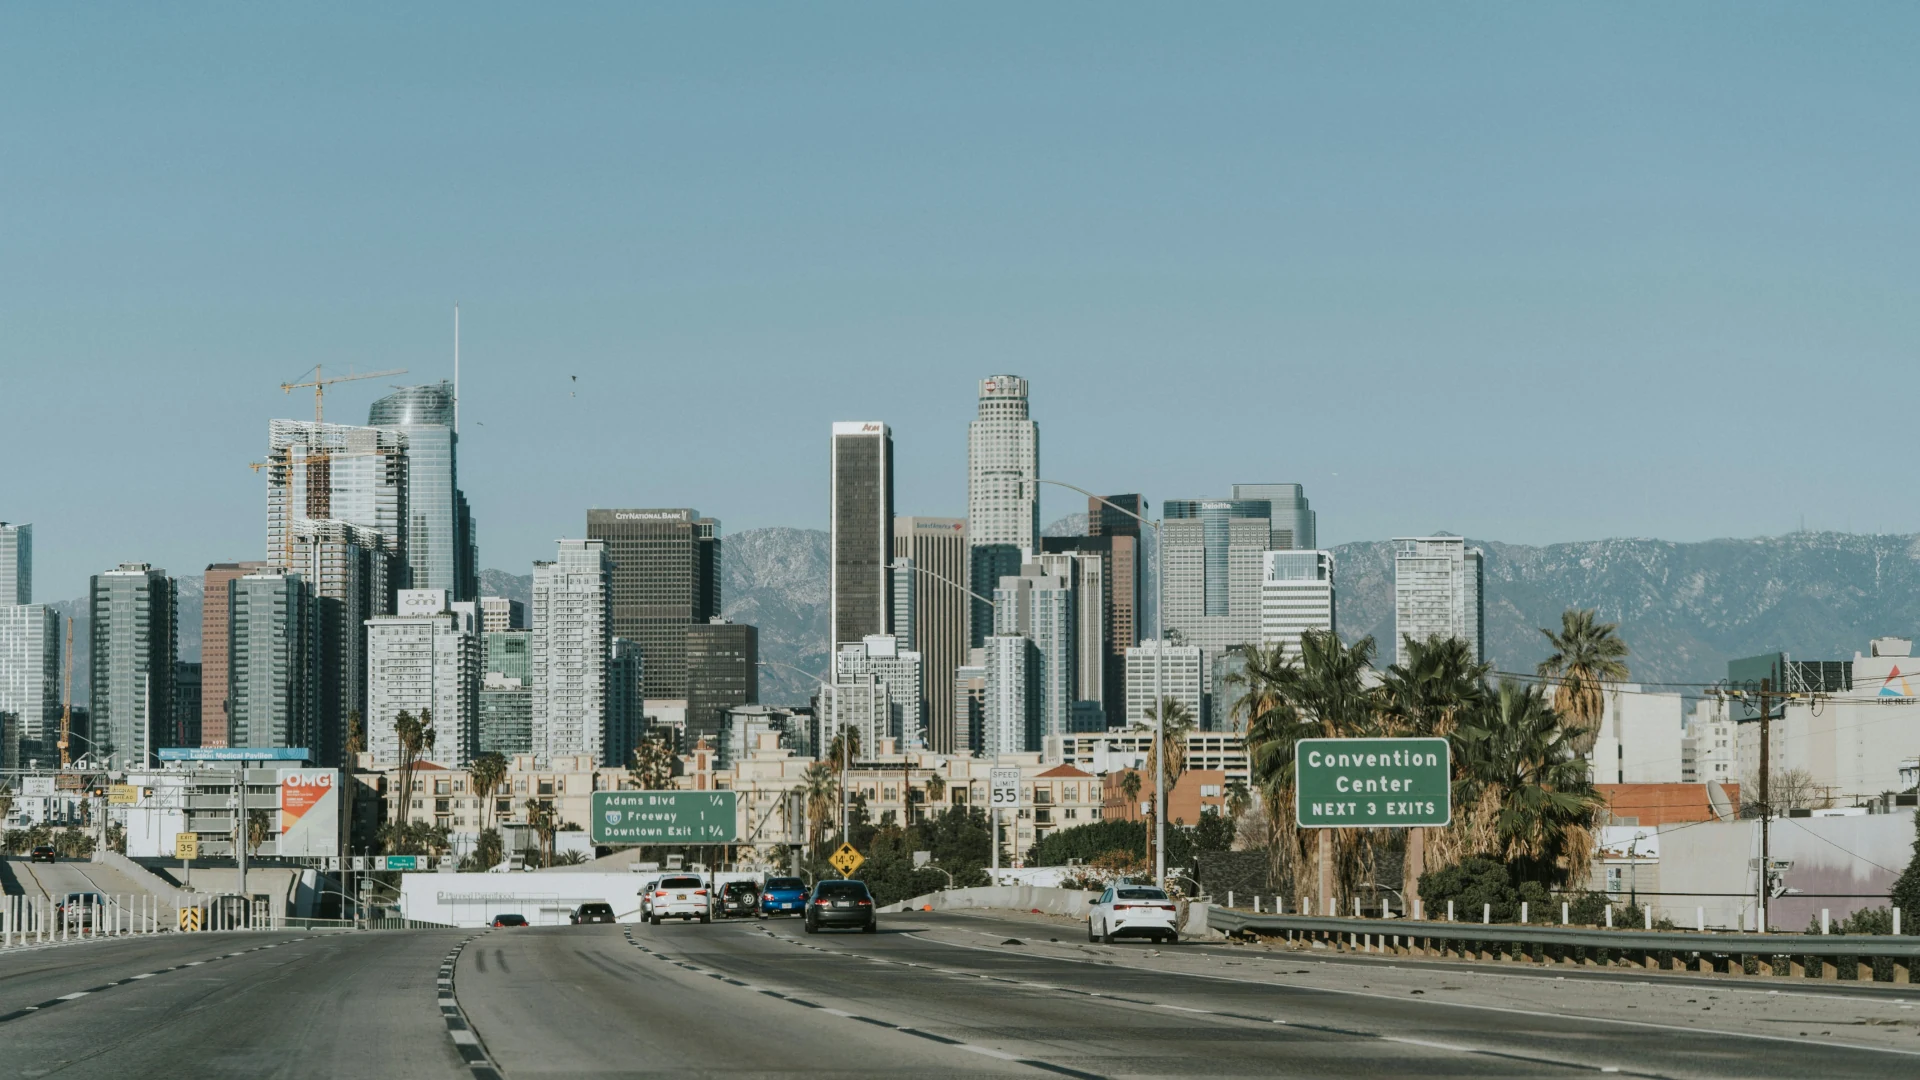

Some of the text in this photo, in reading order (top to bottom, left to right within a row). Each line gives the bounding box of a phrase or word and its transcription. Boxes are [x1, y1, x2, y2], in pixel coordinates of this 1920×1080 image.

[1308, 750, 1437, 767] Convention
[286, 773, 334, 787] OMG!
[1336, 776, 1413, 793] Center
[605, 796, 643, 806] Adams
[649, 796, 675, 806] Blvd
[993, 788, 1016, 803] 55
[1312, 802, 1435, 816] NEXT 3 EXITS
[628, 811, 705, 823] Freeway 1
[605, 826, 663, 836] Downtown
[667, 826, 692, 836] Exit
[700, 826, 705, 836] 1
[180, 844, 193, 852] 35
